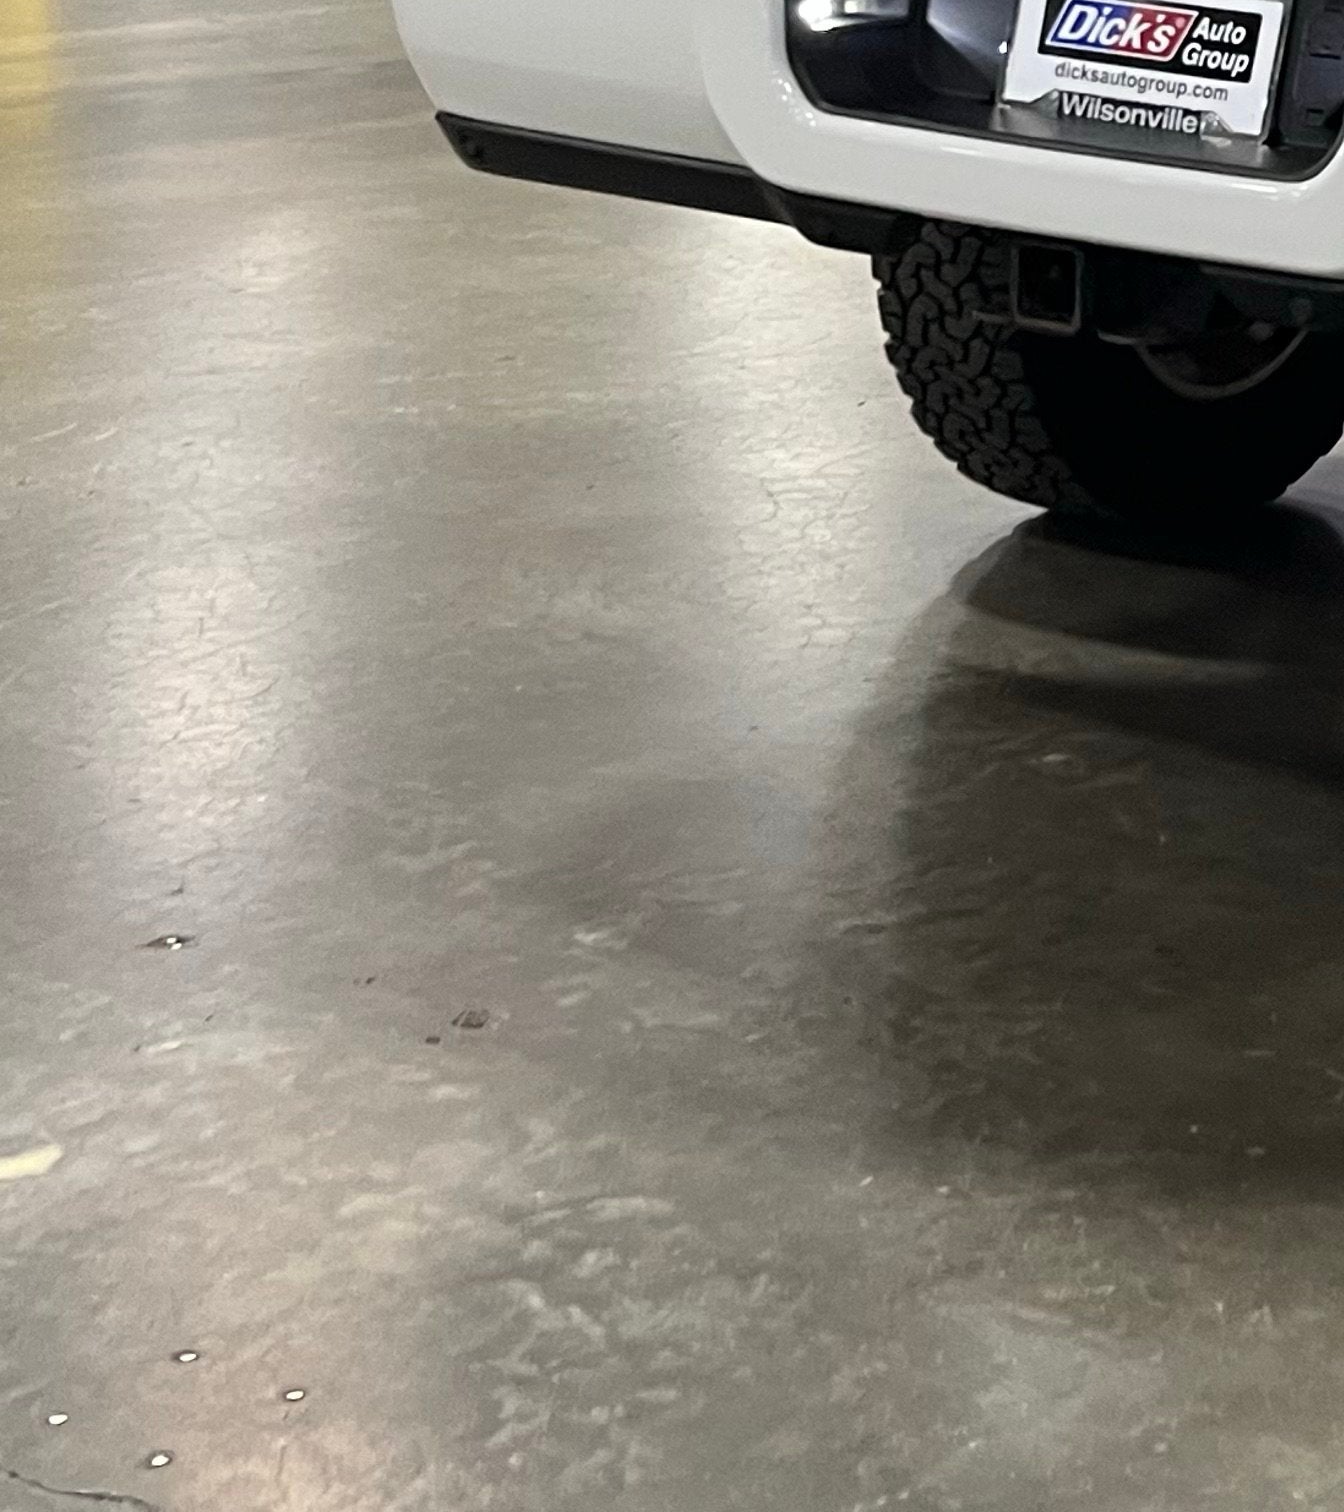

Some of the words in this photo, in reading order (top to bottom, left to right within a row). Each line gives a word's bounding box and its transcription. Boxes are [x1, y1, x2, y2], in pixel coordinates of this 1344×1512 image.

[1193, 16, 1247, 45] Auto
[1181, 42, 1250, 78] Group
[1054, 61, 1229, 102] dicksautogroup.com
[1061, 93, 1199, 135] Wilsonville
